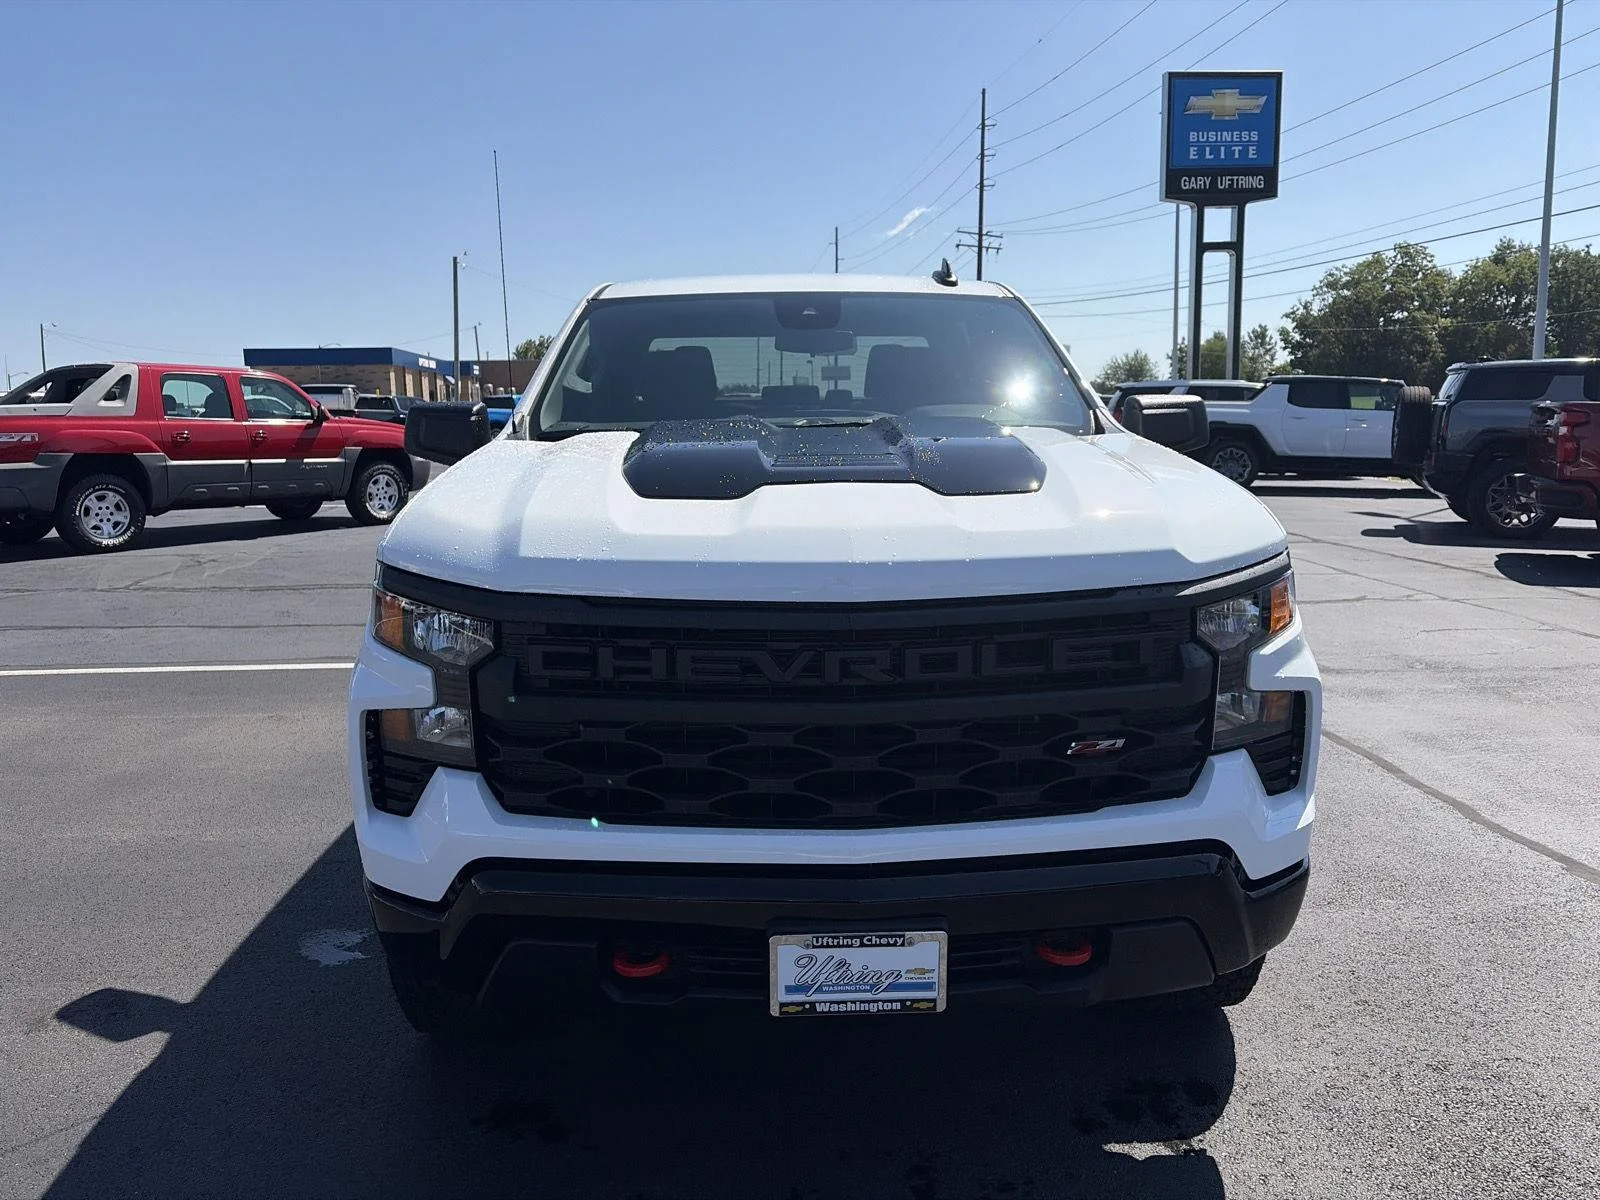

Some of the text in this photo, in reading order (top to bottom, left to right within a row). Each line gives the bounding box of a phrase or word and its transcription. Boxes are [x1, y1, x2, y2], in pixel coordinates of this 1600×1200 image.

[1189, 131, 1259, 142] BUSINESS
[1189, 146, 1258, 159] ELITE
[1181, 175, 1265, 190] GARY UFTRING
[527, 632, 1177, 686] CHEVROLET
[812, 936, 904, 947] Uftring Chevy
[794, 953, 903, 997] Uftring
[816, 1001, 901, 1013] Washington
